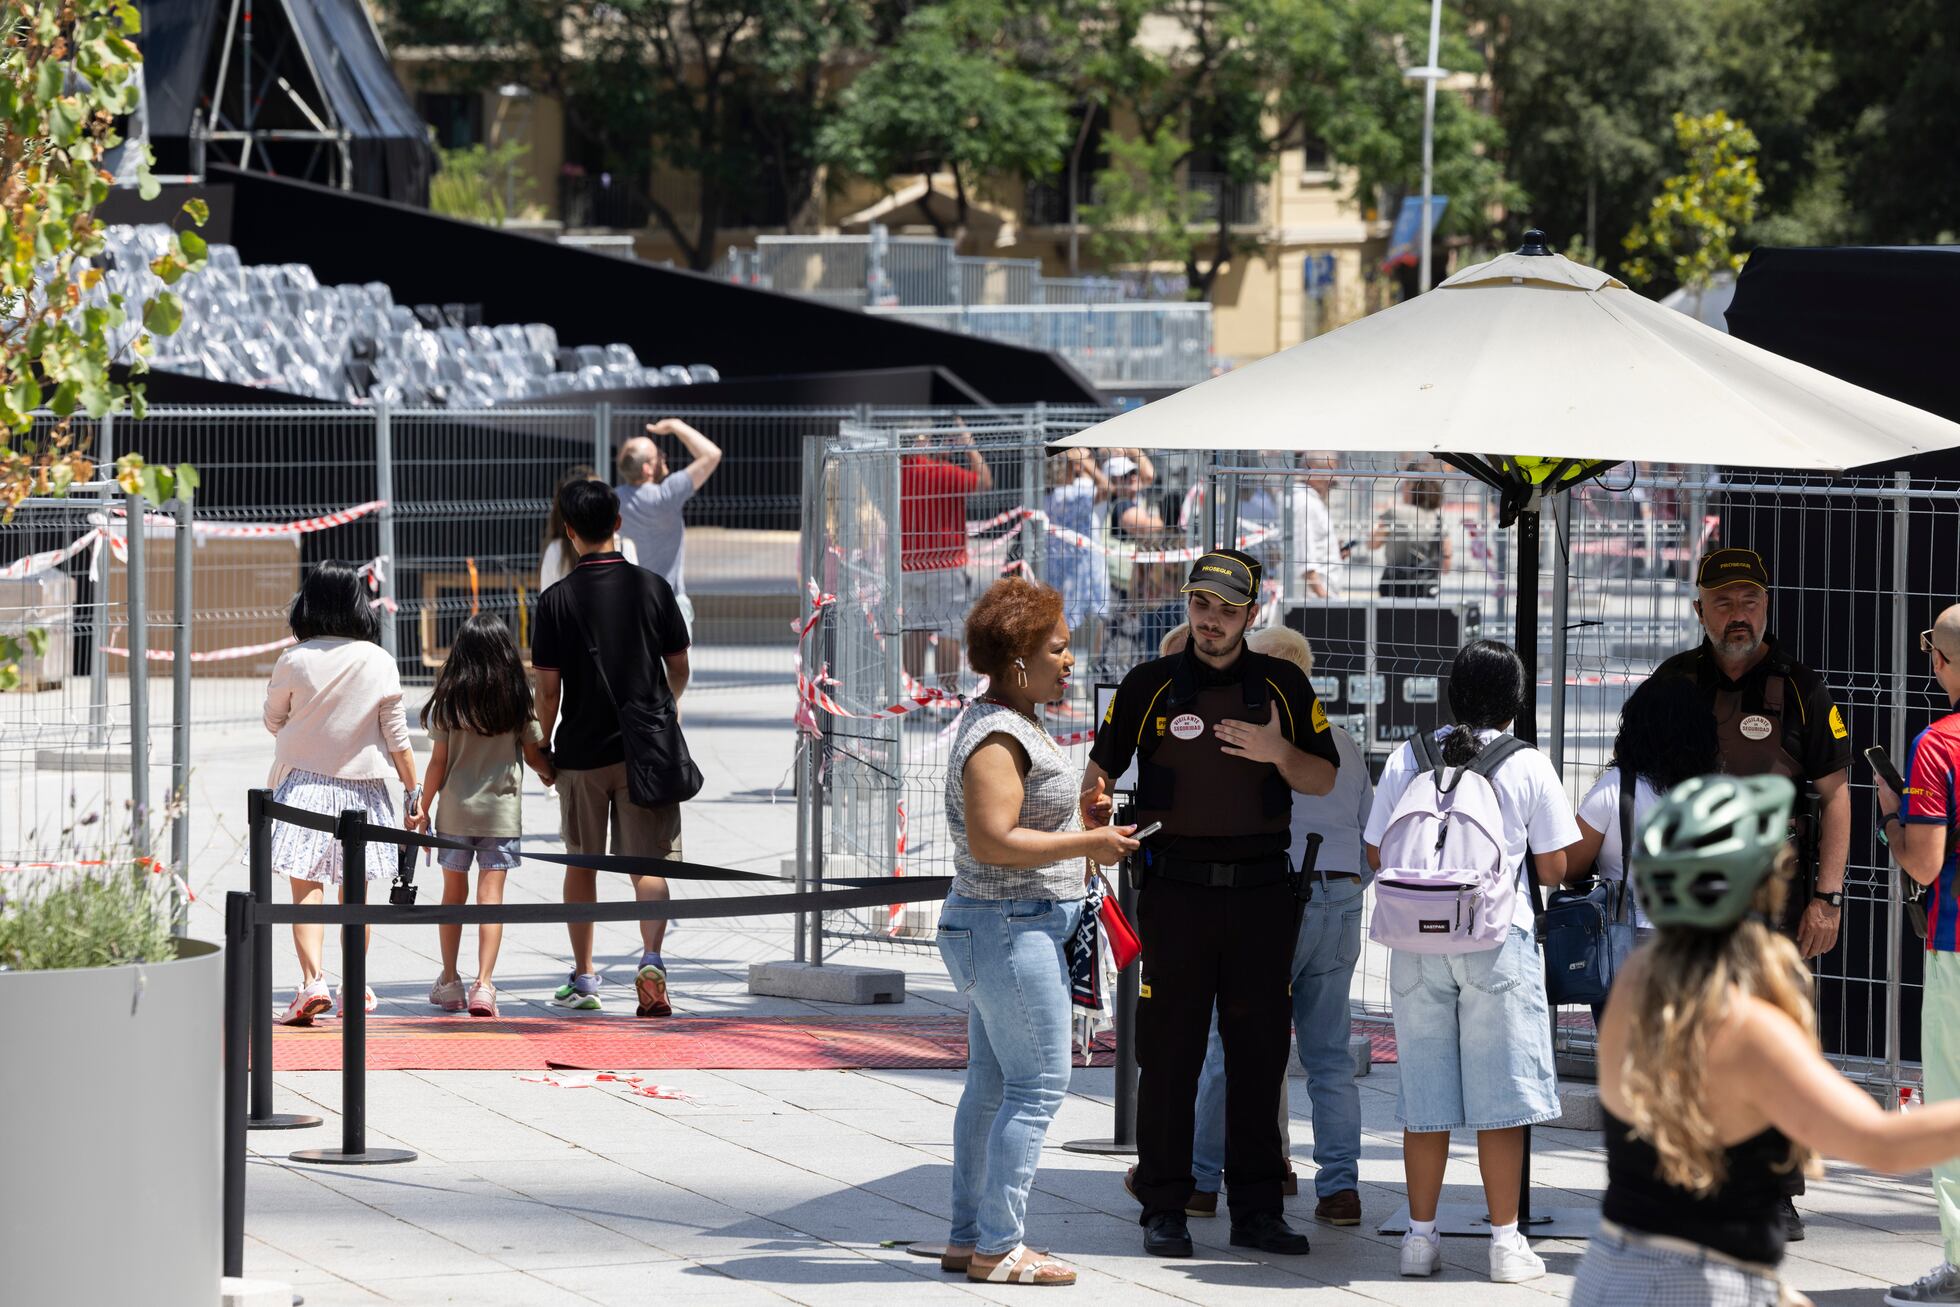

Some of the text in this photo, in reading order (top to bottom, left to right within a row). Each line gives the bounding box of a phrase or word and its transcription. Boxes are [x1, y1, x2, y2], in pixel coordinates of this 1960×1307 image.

[1201, 565, 1233, 576] PROSEGUR
[1174, 716, 1200, 726] VIGILANTE
[1742, 717, 1770, 727] VIGILANTE
